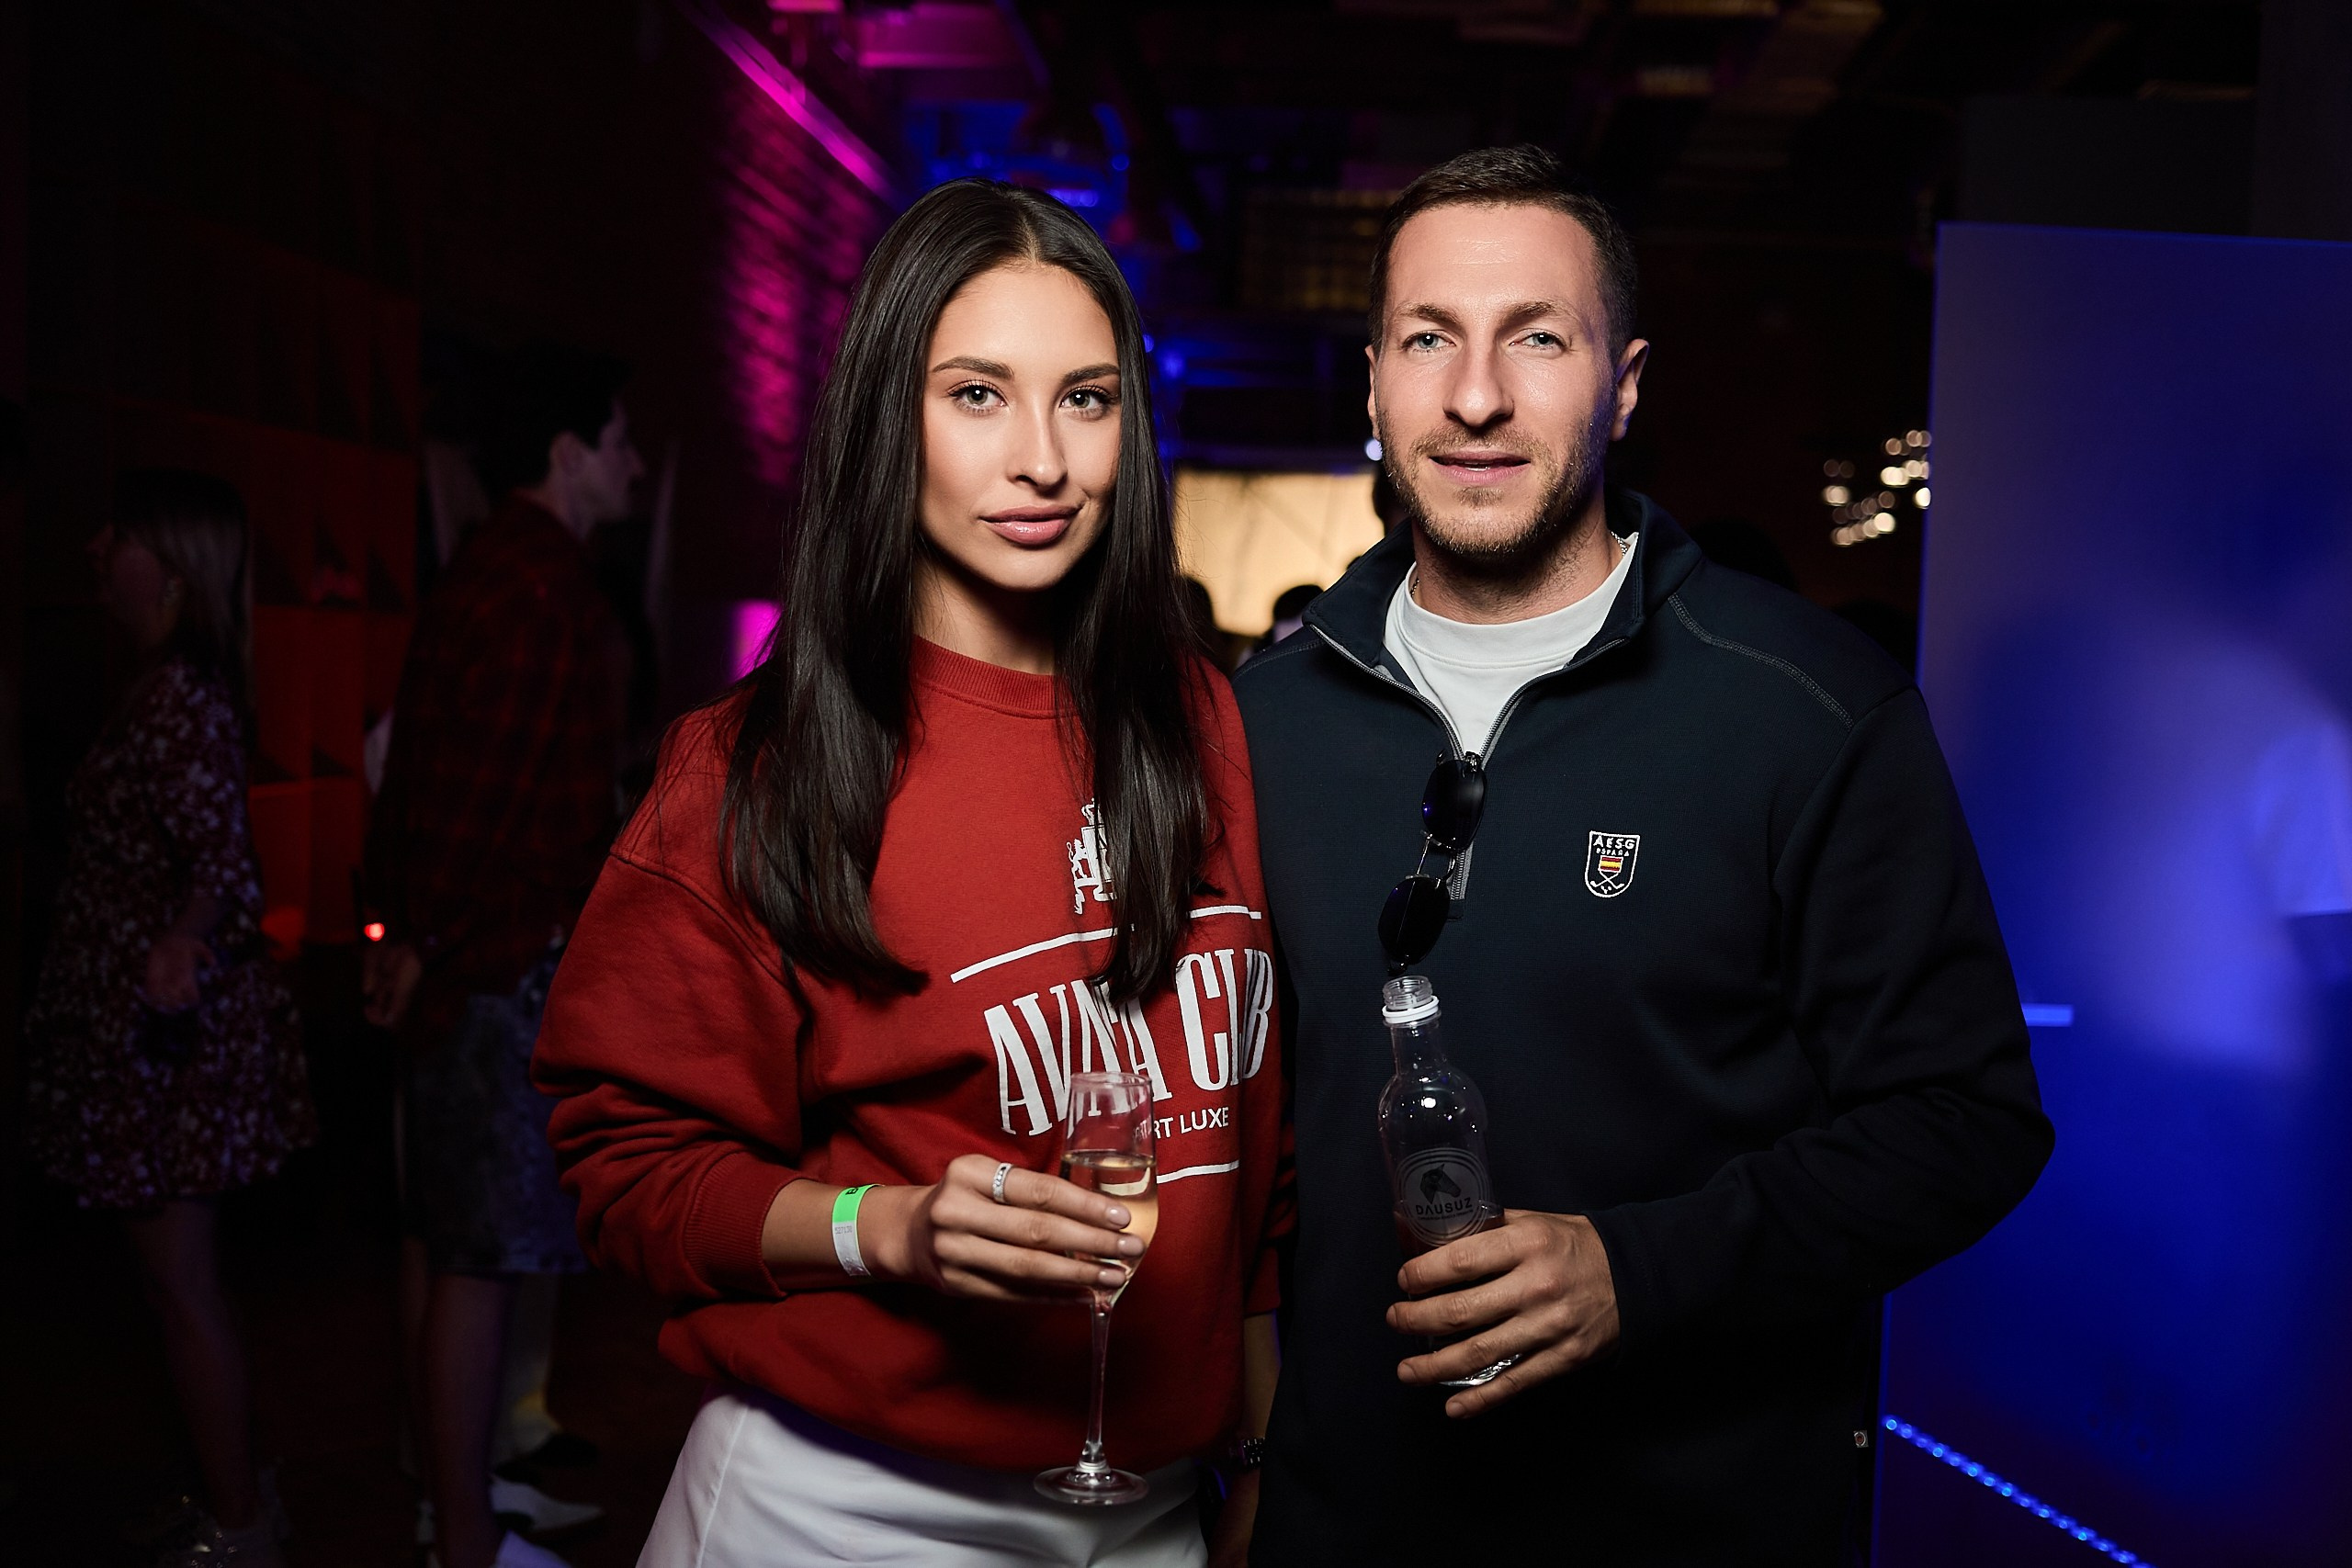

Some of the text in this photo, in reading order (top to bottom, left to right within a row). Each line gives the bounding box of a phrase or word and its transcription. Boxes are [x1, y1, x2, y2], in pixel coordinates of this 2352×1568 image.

[1593, 836, 1635, 849] AESG
[1180, 1107, 1229, 1134] LUXE
[1416, 1197, 1473, 1215] DAUSUZ
